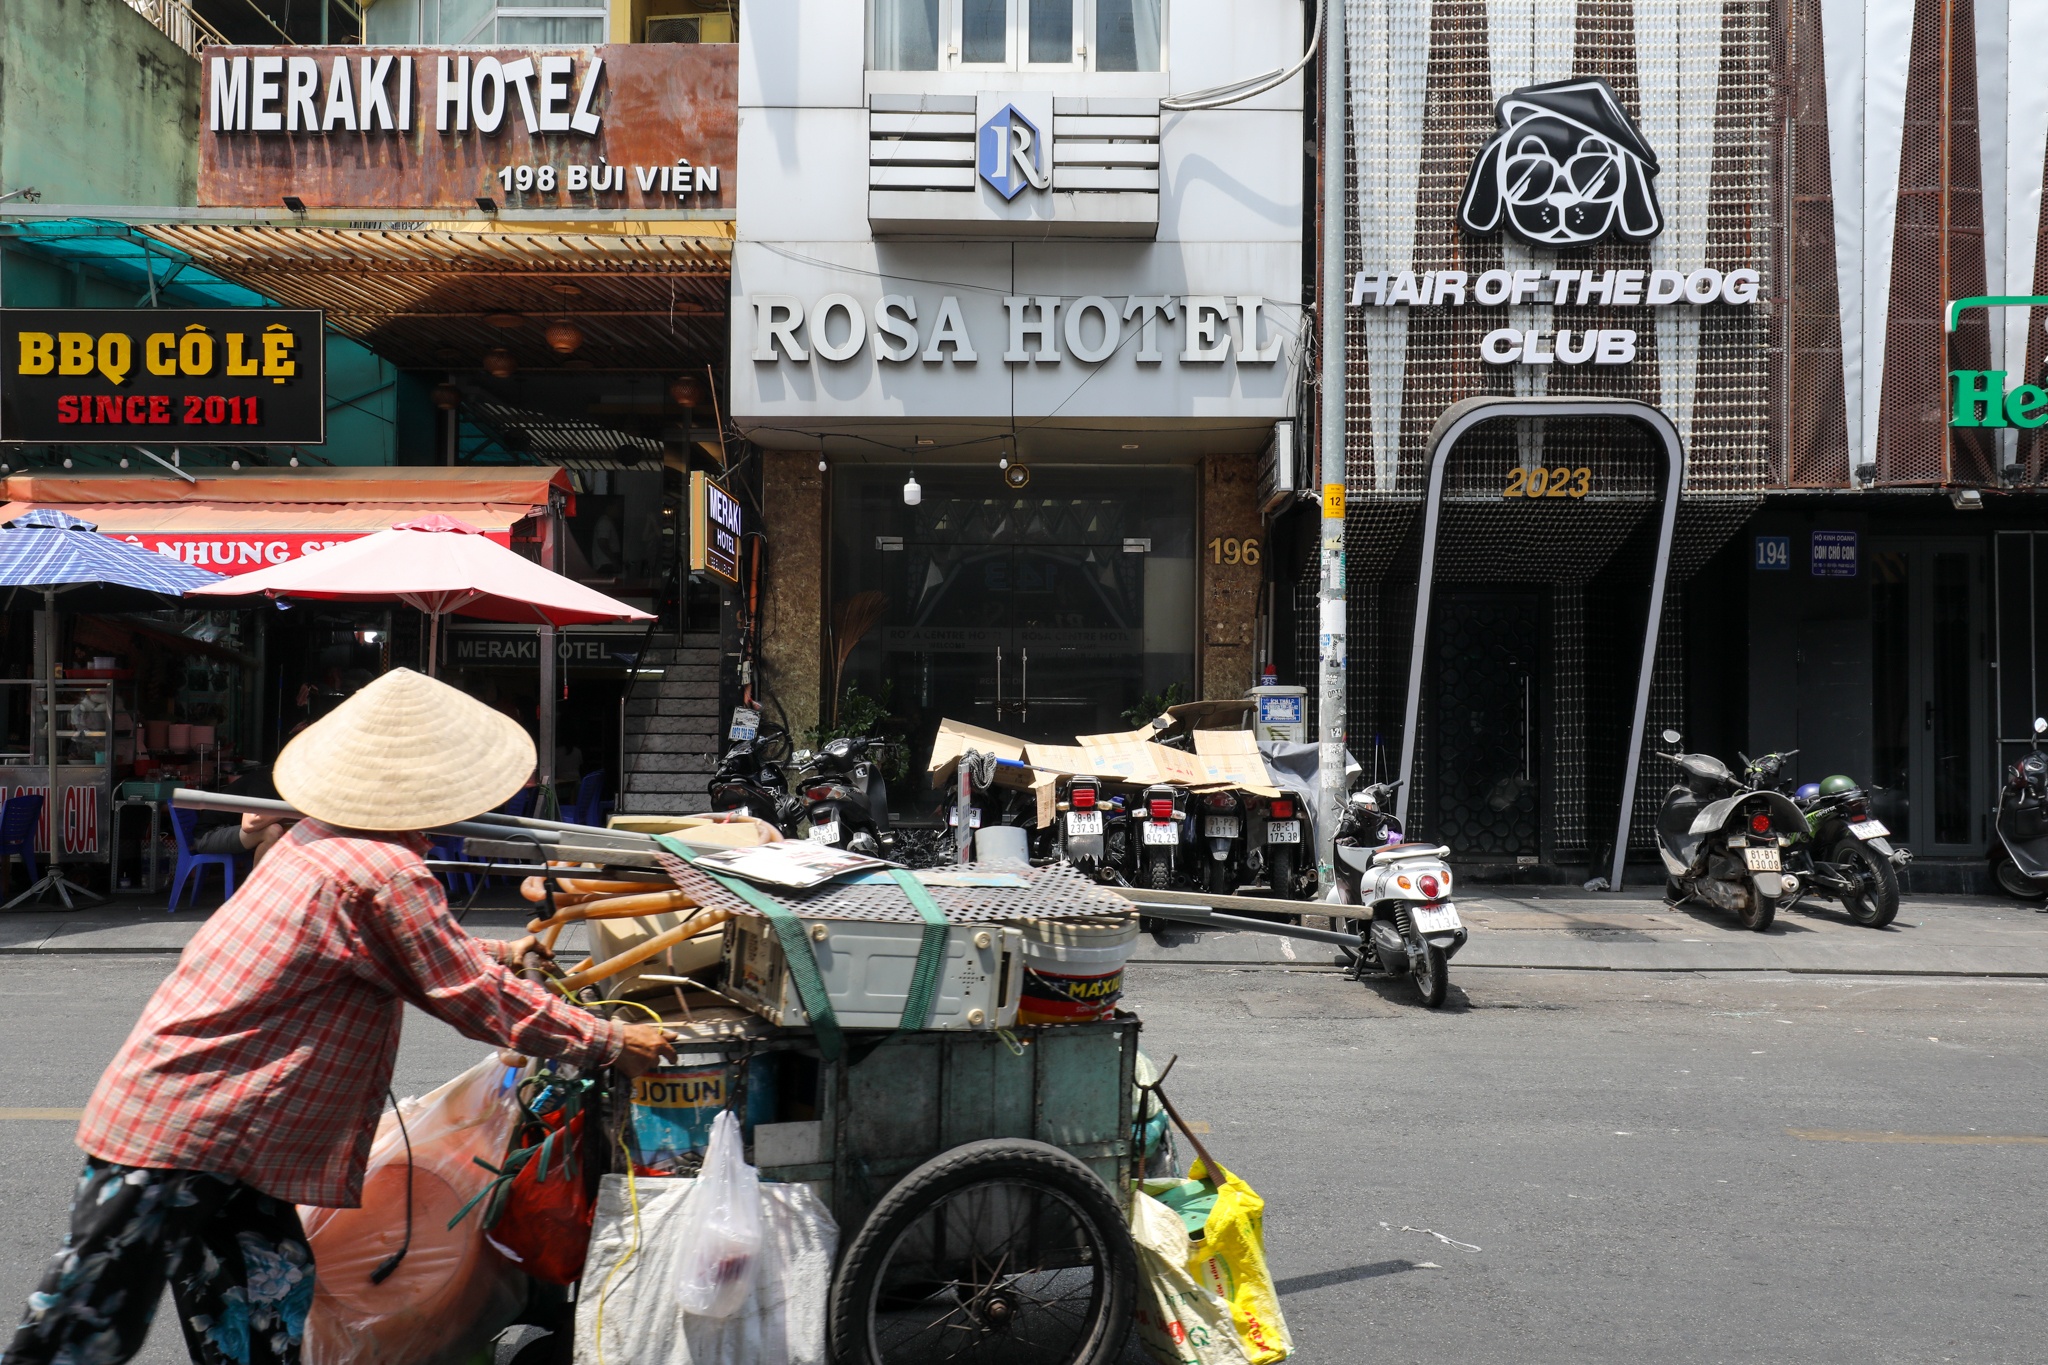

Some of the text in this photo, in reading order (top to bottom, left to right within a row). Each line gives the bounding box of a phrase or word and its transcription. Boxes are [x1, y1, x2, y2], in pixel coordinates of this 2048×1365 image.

[210, 55, 603, 135] MERAKI HOTEL
[498, 156, 718, 200] 198 BÙI VIỆN
[1474, 269, 1541, 306] OF
[1549, 269, 1645, 306] THE
[1645, 268, 1760, 306] DOG
[752, 293, 1283, 364] ROSA HOTEL
[18, 323, 295, 386] BBQ CÔ LỆ
[1481, 328, 1637, 366] CLUB
[57, 395, 258, 424] SINCE 2011
[1503, 467, 1592, 499] 2023
[708, 484, 742, 537] MERAKI
[1330, 496, 1341, 507] 12
[156, 541, 290, 565] NHUNG
[717, 528, 735, 555] HOTEL
[1208, 537, 1260, 566] 196
[1758, 542, 1787, 564] 194
[1814, 543, 1855, 560] CON CHÓ CON
[924, 630, 965, 640] CENTRE
[458, 641, 611, 660] MERAKI OTEL
[64, 785, 98, 854] CUA
[1070, 823, 1100, 834] 237.91
[1073, 813, 1096, 823] 28-B1
[1146, 833, 1177, 843] 842.25
[1270, 832, 1298, 842] 175.38
[1750, 859, 1779, 870] 130.08
[641, 1079, 720, 1103] JOTUN
